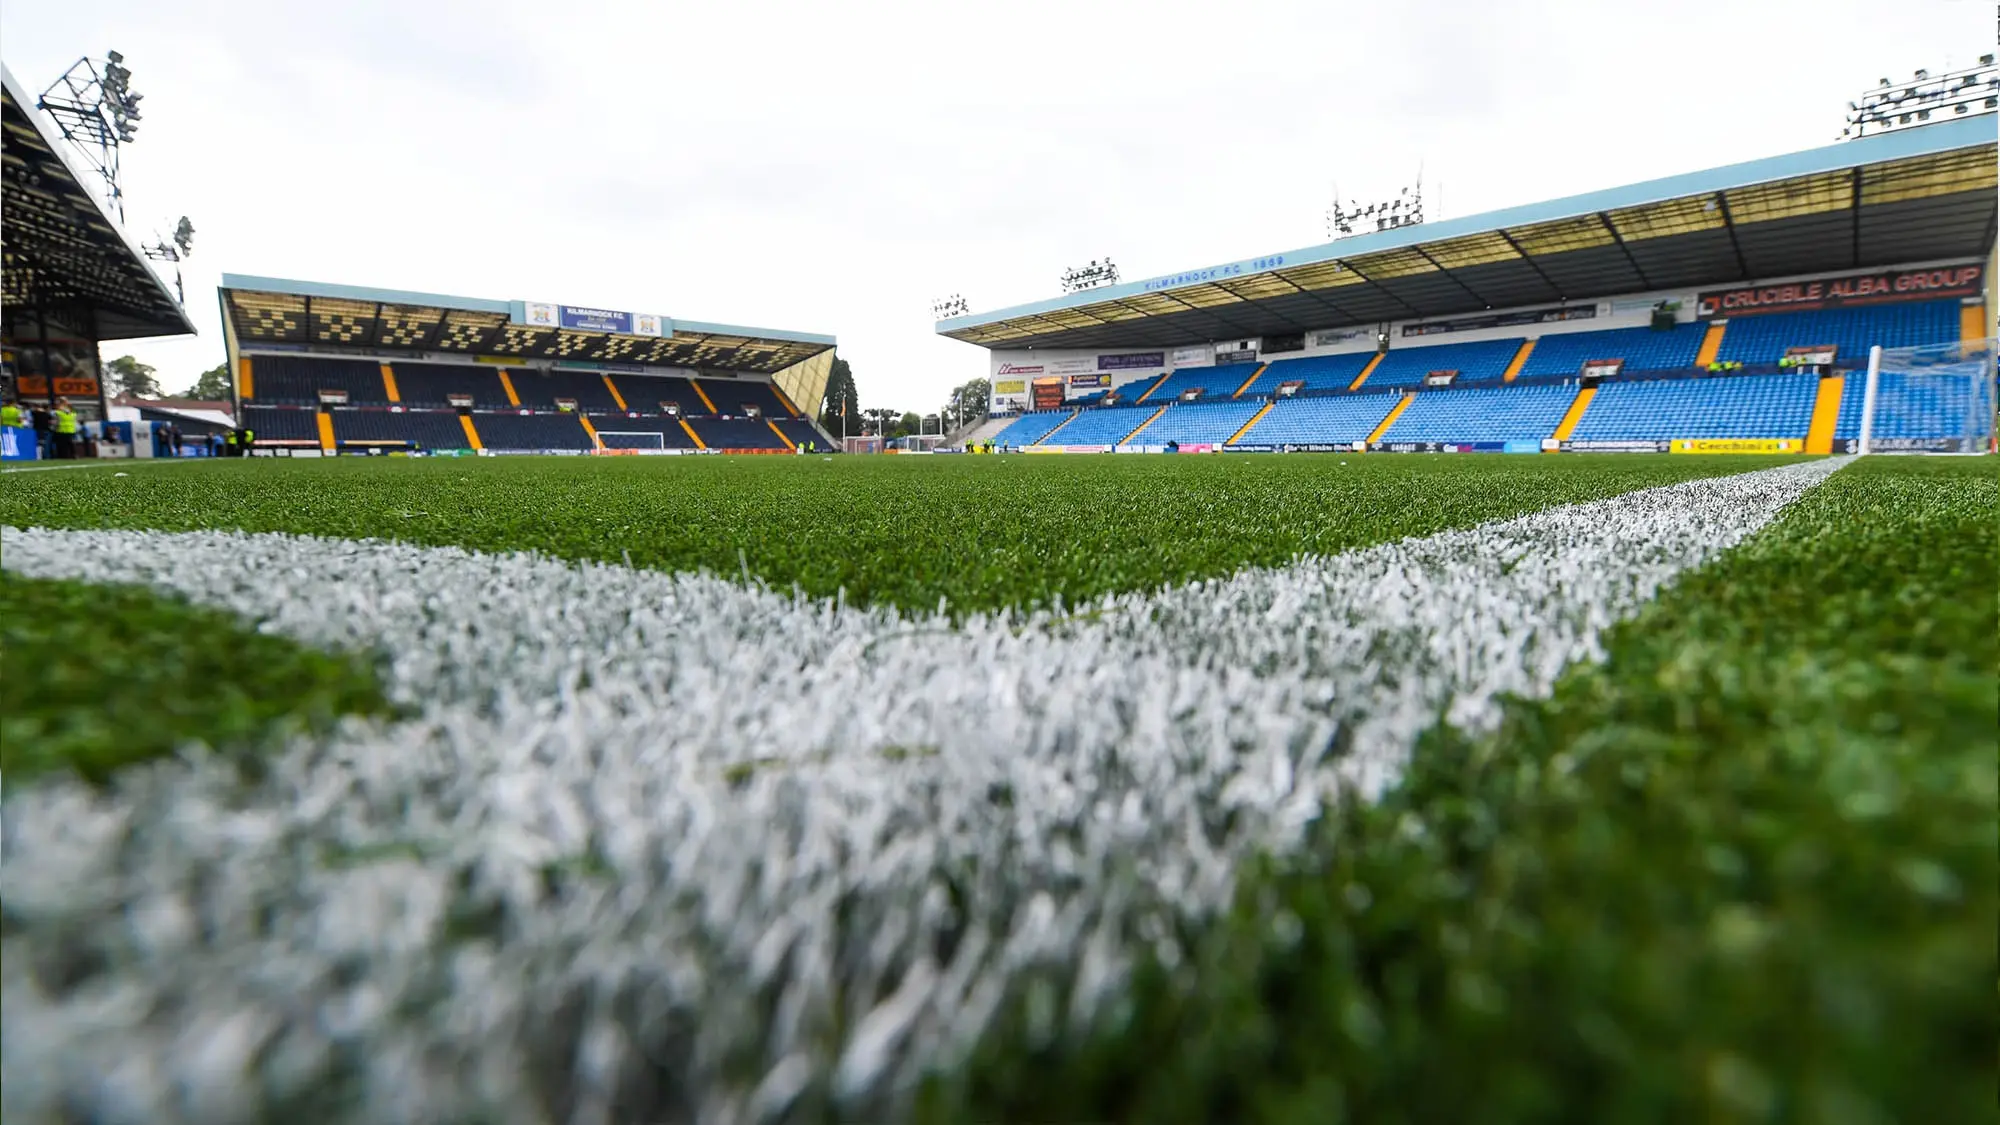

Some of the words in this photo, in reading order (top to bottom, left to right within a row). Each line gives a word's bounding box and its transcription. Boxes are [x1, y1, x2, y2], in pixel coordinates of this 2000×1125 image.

[1145, 270, 1216, 291] KILMARNOCK
[1253, 256, 1284, 270] 1869
[1722, 283, 1822, 308] CRUCIBLE
[1826, 276, 1891, 298] ALBA
[1894, 266, 1980, 291] GROUP
